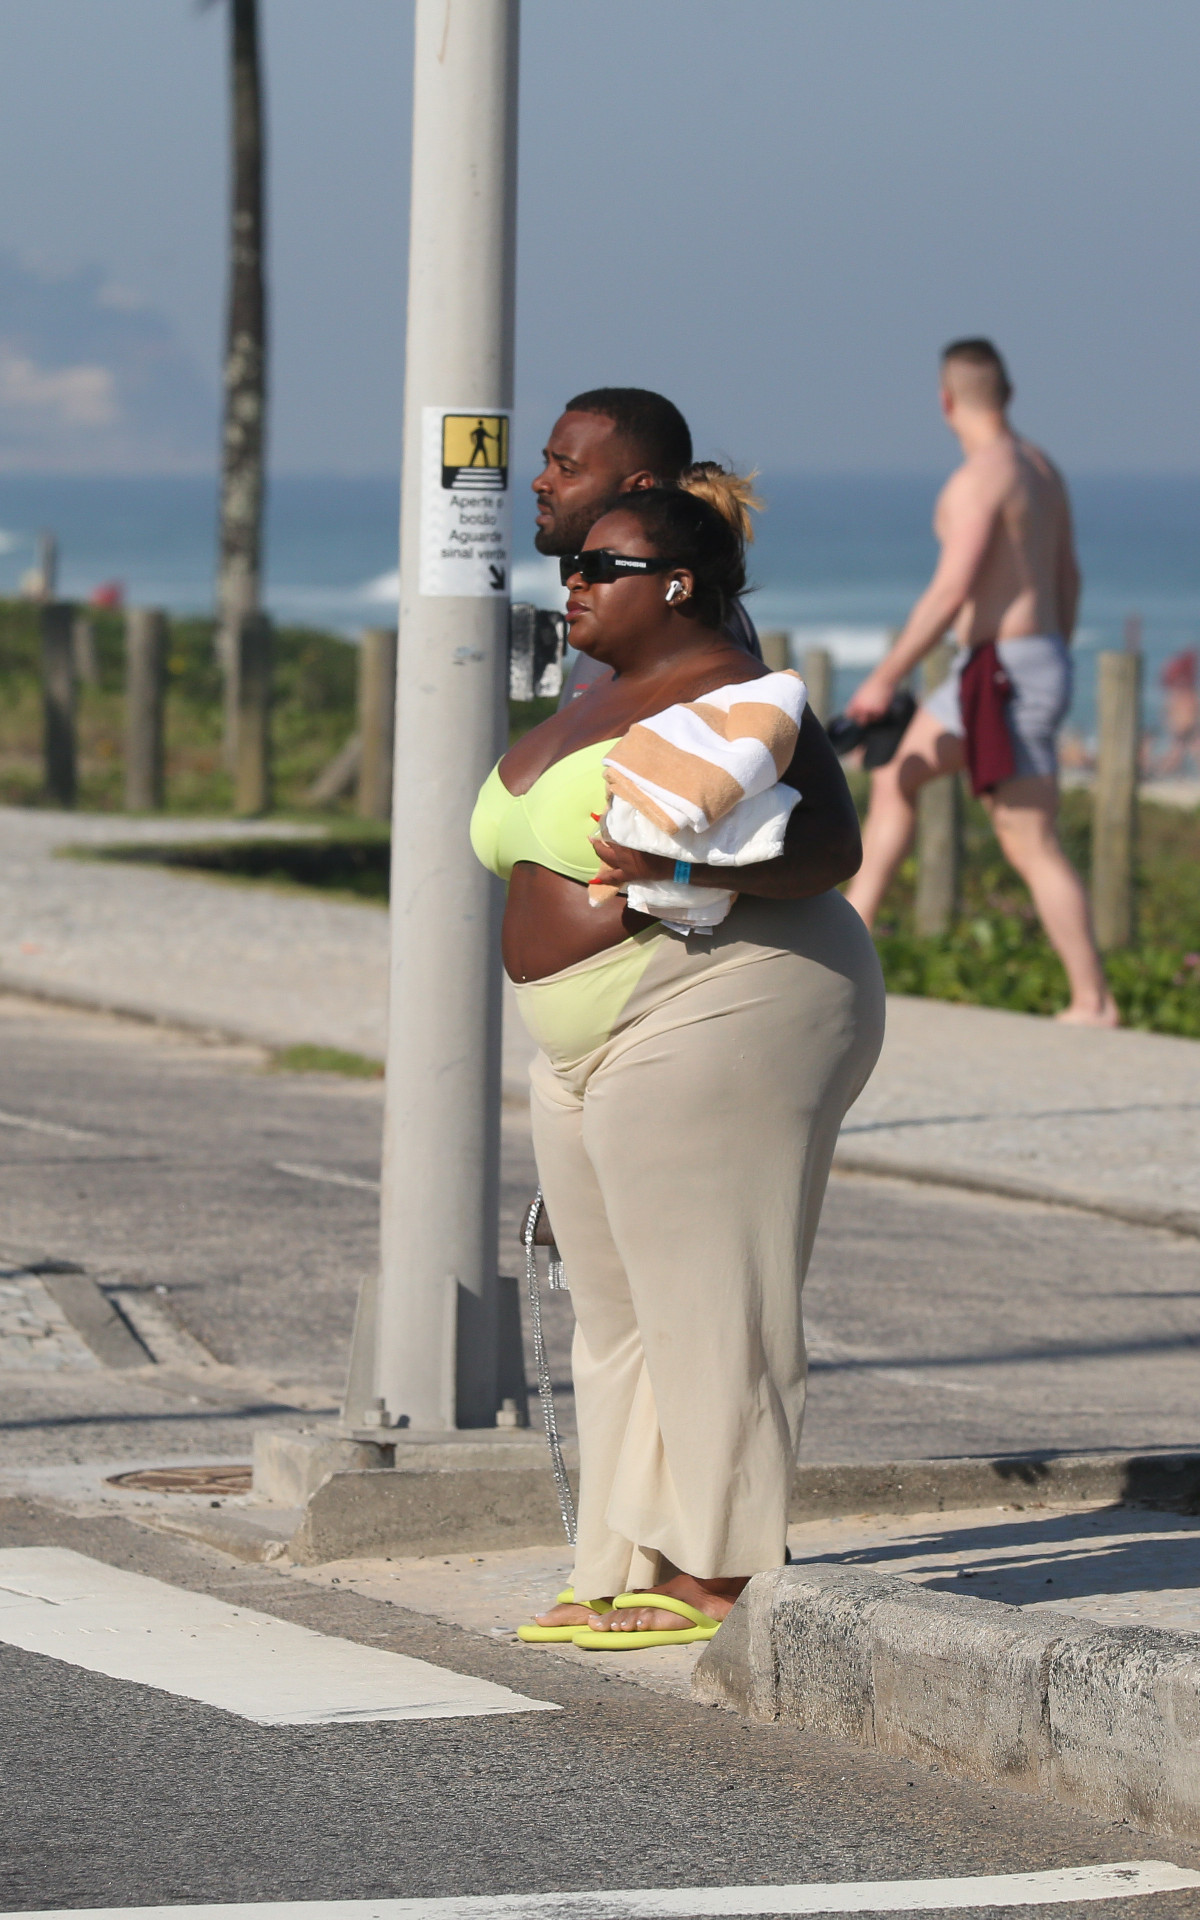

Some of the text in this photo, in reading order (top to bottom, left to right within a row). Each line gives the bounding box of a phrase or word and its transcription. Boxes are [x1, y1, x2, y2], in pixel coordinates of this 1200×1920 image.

[450, 495, 493, 508] Aperte
[460, 513, 497, 525] botão
[449, 529, 502, 544] Aguarde
[441, 547, 473, 558] sinal
